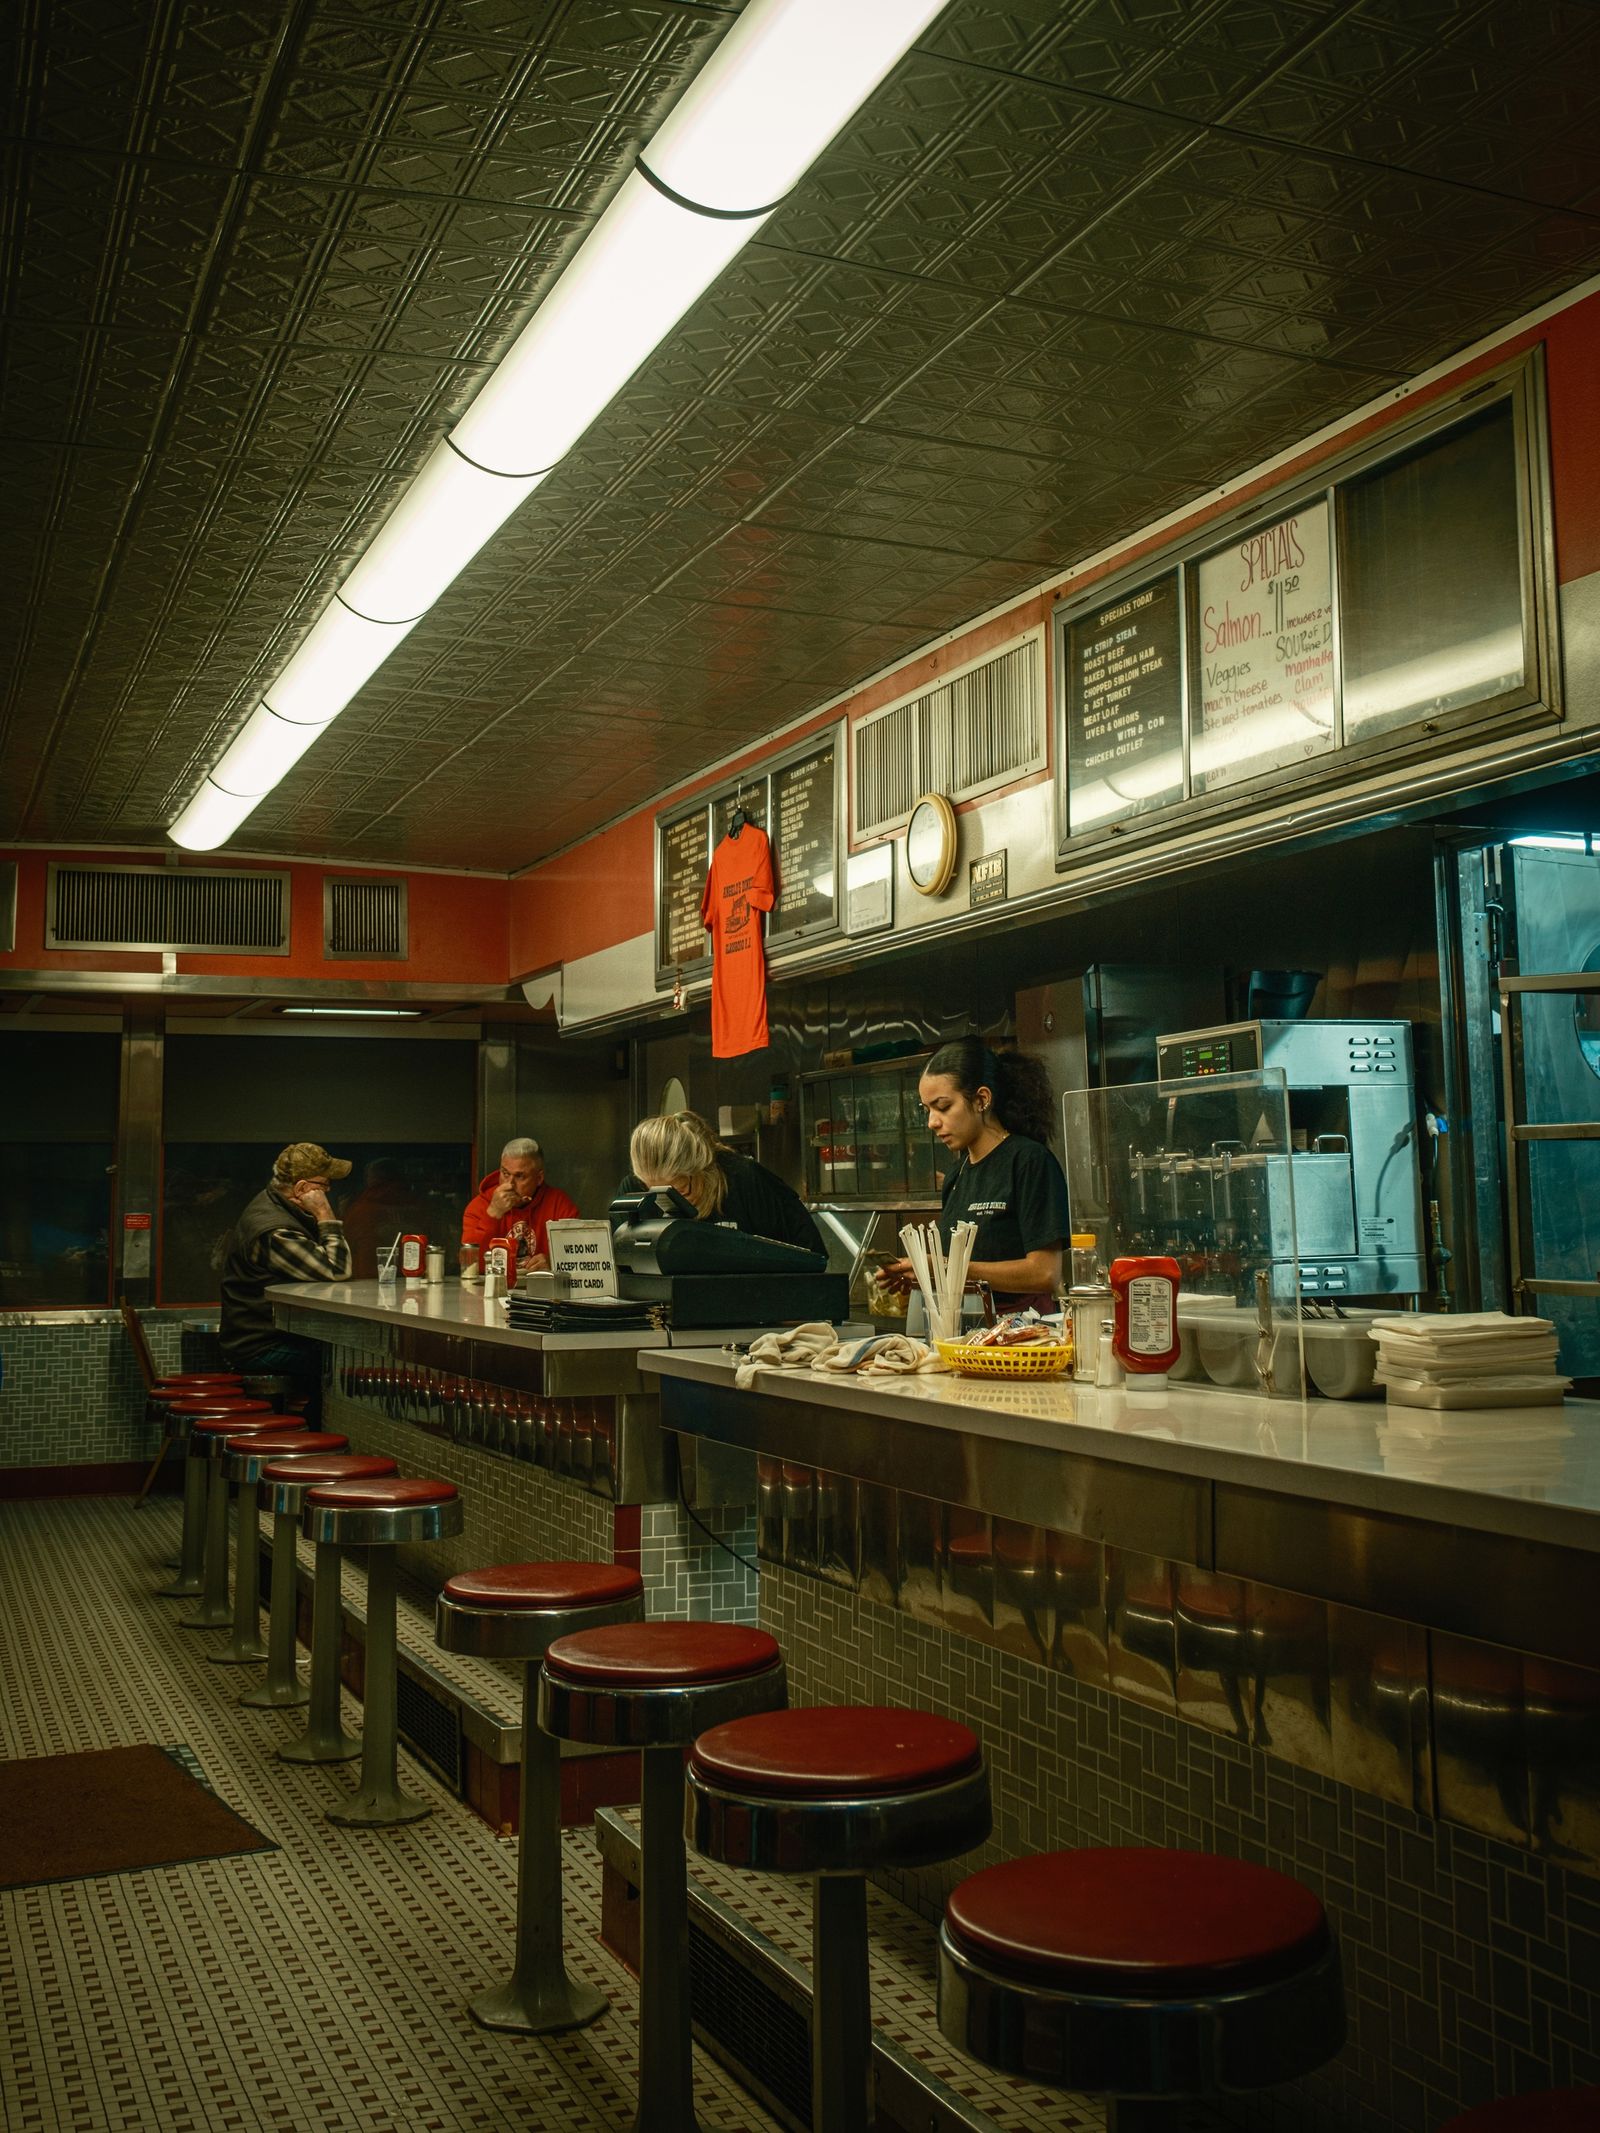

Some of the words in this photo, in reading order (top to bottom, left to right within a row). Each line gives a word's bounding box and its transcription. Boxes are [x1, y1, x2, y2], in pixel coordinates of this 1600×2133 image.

[1240, 519, 1305, 592] SPECIALS
[1100, 603, 1131, 626] SPECIALS
[1133, 591, 1153, 610] TODAY
[1316, 608, 1322, 618] 2
[1083, 646, 1093, 659] NY
[1094, 637, 1114, 654] STRIP
[1116, 625, 1137, 644] STEAK
[1083, 654, 1106, 673] ROAST
[1107, 645, 1125, 661] BEEF
[1083, 669, 1105, 686] BAKED
[1107, 654, 1138, 675] VIRGINIA
[1138, 646, 1155, 662] HAM
[1083, 679, 1113, 699] CHOPPED
[1113, 667, 1140, 687] SIRLOIN
[1141, 657, 1163, 675] STEAK
[1206, 662, 1251, 694] Veggies
[1106, 685, 1132, 703] TURKEY
[1242, 692, 1283, 717] tomatoes
[1083, 712, 1100, 727] MEAT
[1101, 704, 1120, 720] LOAF
[1085, 724, 1105, 740] LIVER
[1113, 710, 1140, 729] ONIONS
[1117, 726, 1136, 742] WITH
[1085, 749, 1114, 767] CHICKEN
[1116, 737, 1144, 757] CUTLET
[563, 1244, 574, 1254] WE
[574, 1244, 584, 1254] DO
[585, 1243, 598, 1254] NOT
[556, 1262, 578, 1272] ACCEPT
[578, 1261, 601, 1271] CREDIT
[601, 1261, 612, 1271] OR
[583, 1278, 604, 1289] CARDS
